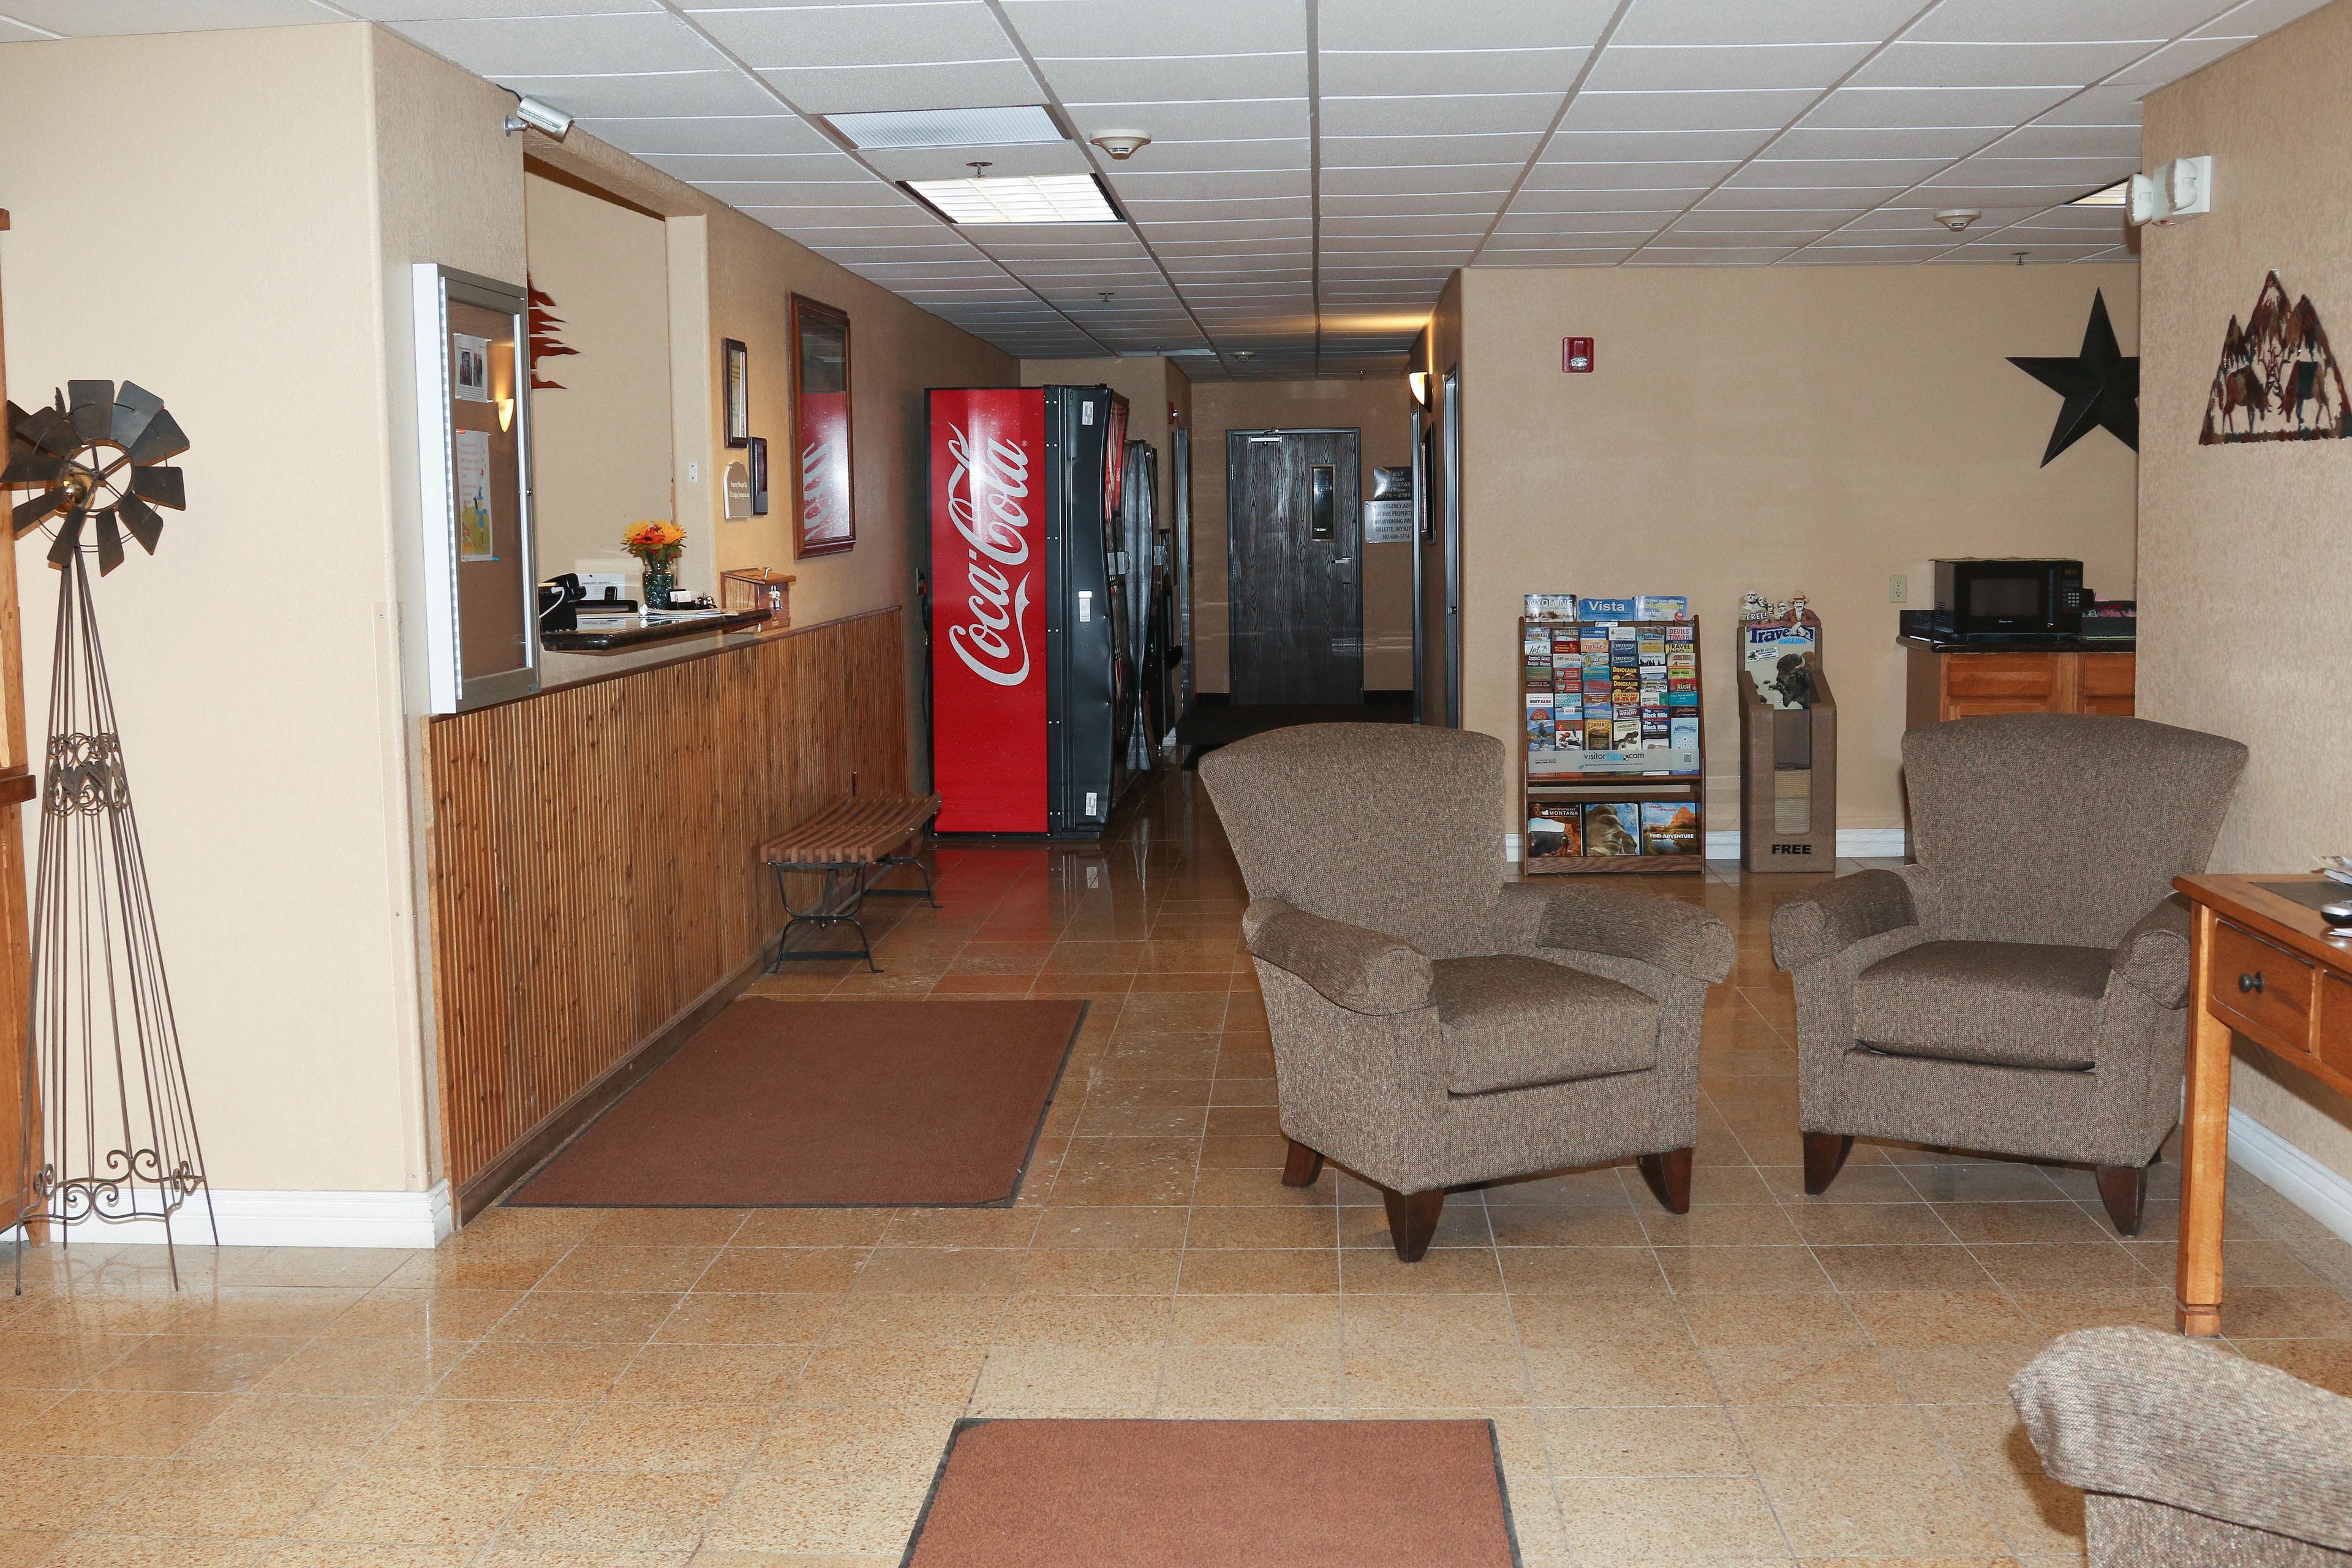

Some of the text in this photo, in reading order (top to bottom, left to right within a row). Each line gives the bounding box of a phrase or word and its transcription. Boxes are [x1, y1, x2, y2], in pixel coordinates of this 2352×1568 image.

[948, 421, 1030, 686] Coca-Cola
[1589, 600, 1624, 611] Vista
[1772, 844, 1811, 854] FREE
